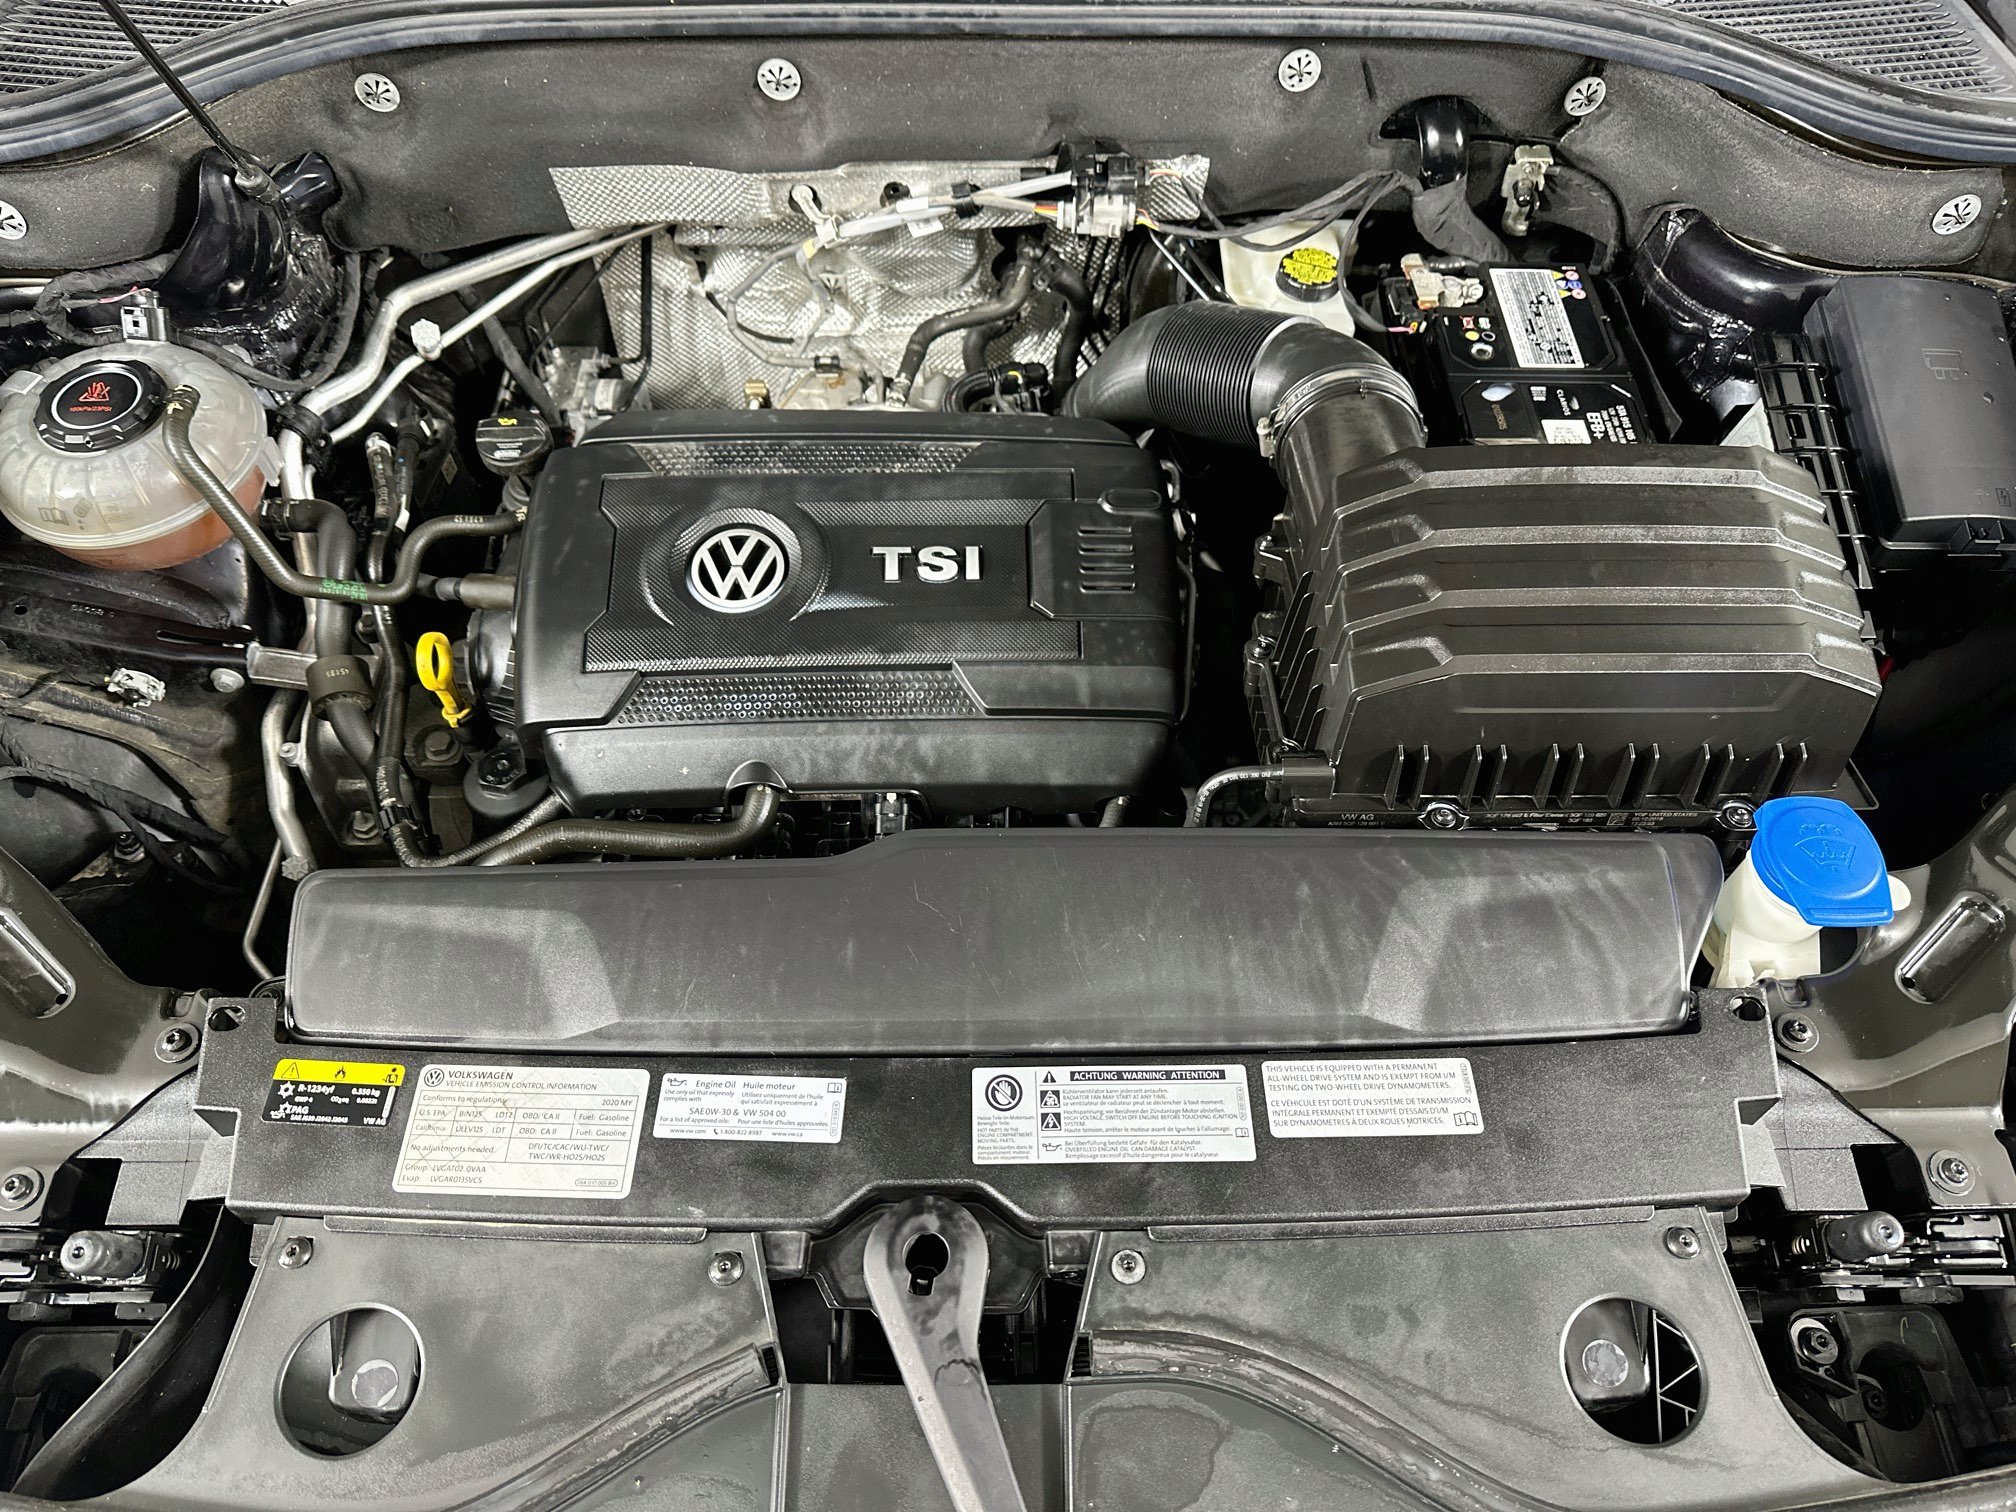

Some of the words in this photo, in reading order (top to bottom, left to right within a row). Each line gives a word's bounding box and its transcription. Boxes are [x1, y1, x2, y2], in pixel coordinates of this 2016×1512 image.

[1556, 389, 1571, 416] CLARIOS
[1586, 412, 1606, 440] EFB+
[872, 546, 984, 583] TSI
[448, 1070, 513, 1079] VOLKSWAGEN
[1074, 1071, 1117, 1080] ACHTUNG
[1123, 1071, 1166, 1079] WARNING
[1171, 1070, 1219, 1079] ATTENTION
[695, 1080, 723, 1089] Engine
[298, 1084, 335, 1095] R-1234yf
[370, 1088, 380, 1098] kg
[1331, 1098, 1351, 1106] DOTÉ
[1373, 1097, 1404, 1105] SYSTÈME
[1366, 1107, 1397, 1115] EXEMPTÉ
[1351, 1117, 1357, 1125] À
[410, 1144, 420, 1153] No
[422, 1144, 465, 1154] adjustments
